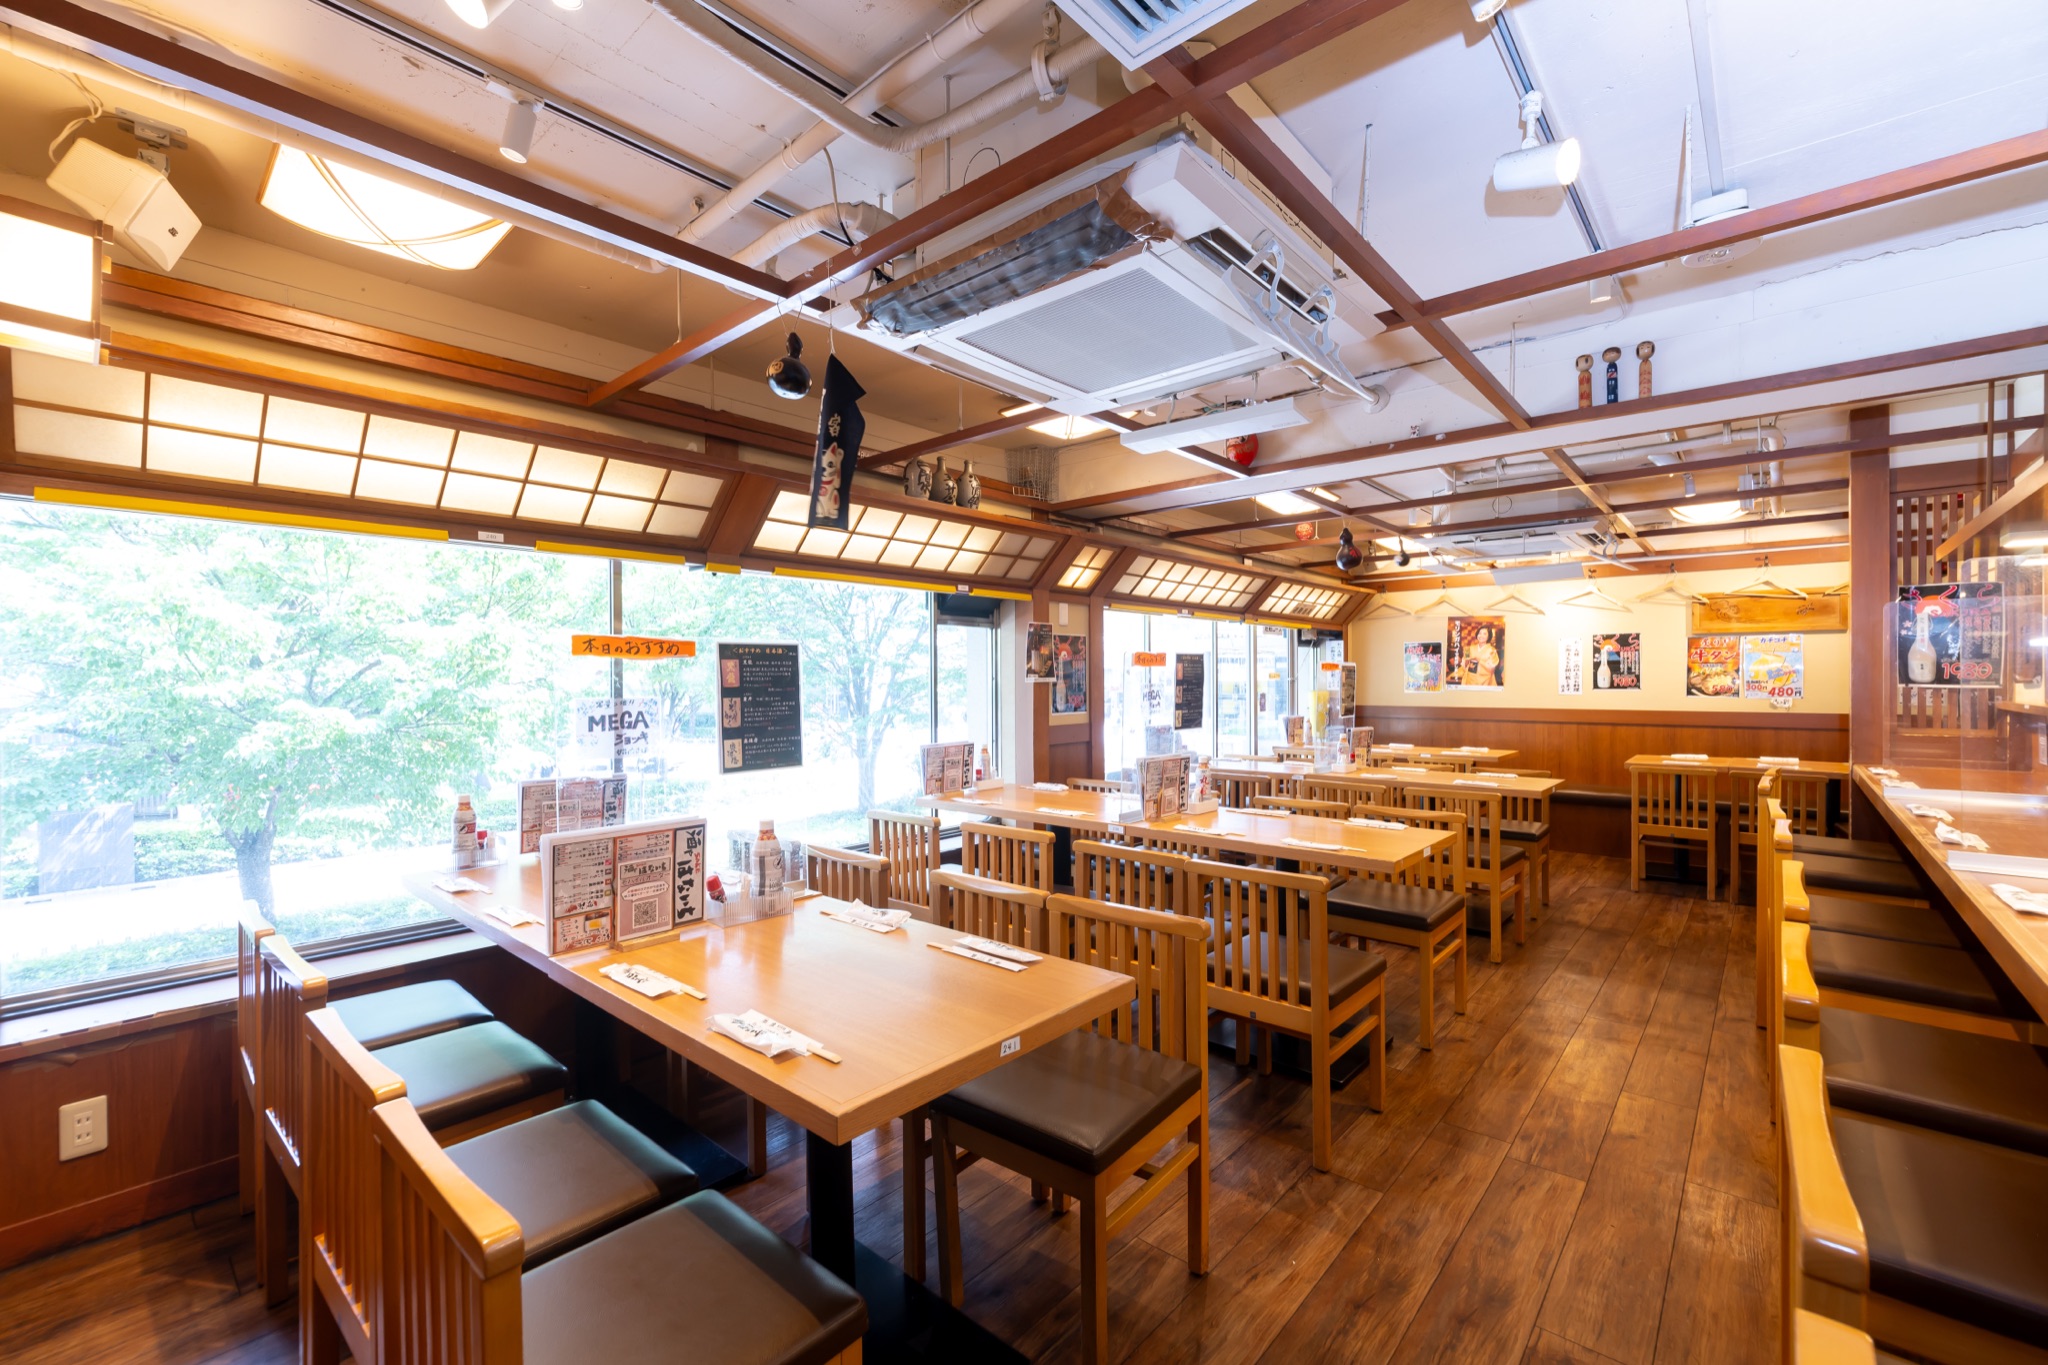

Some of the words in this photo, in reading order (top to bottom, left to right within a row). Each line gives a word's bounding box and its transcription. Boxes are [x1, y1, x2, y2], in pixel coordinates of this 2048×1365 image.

[582, 638, 680, 655] 本日のおすすめ
[1690, 648, 1736, 662] 牛タン
[1941, 661, 1993, 679] 1980
[1768, 686, 1801, 697] 480円
[588, 710, 650, 733] MEGA
[614, 731, 649, 746] ジョッキ
